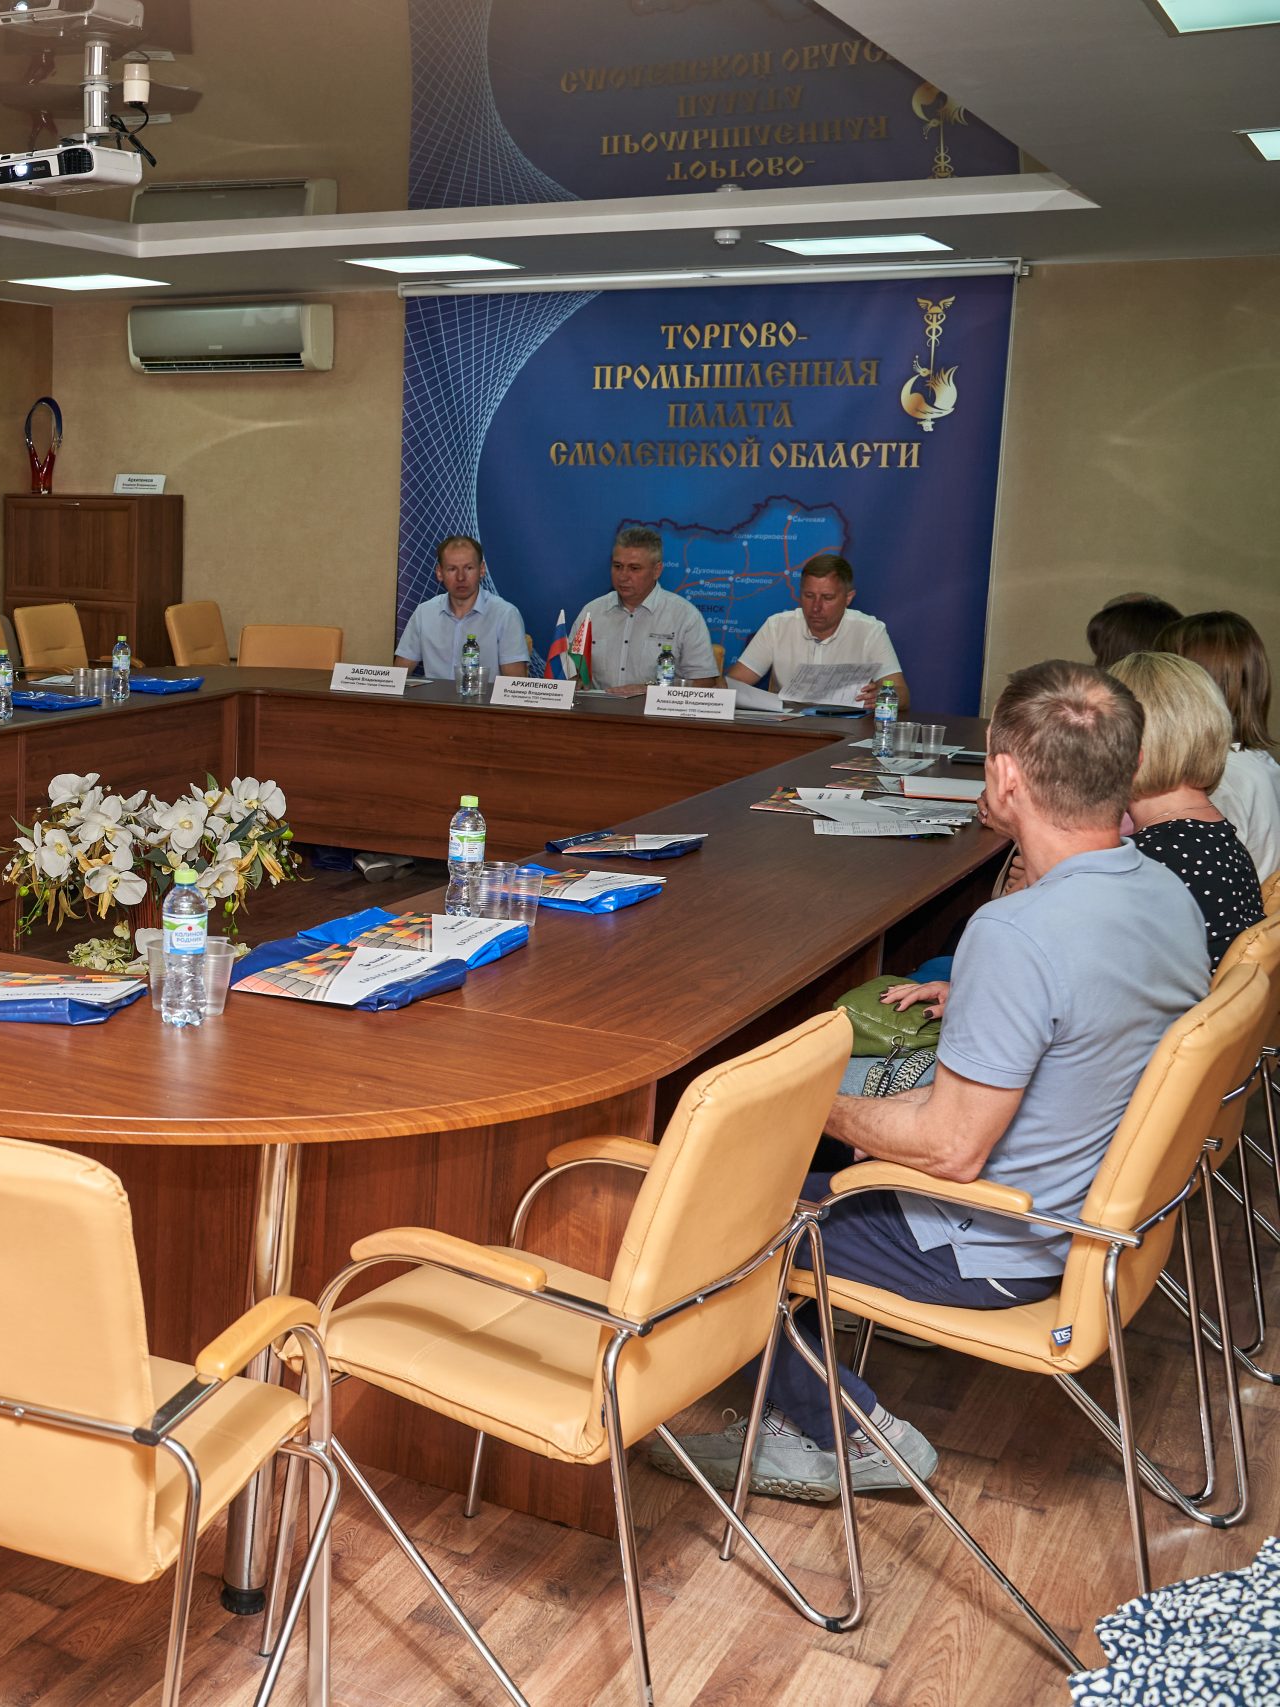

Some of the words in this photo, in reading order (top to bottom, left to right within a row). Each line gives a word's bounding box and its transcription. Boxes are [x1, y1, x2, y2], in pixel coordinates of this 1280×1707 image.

[660, 320, 808, 351] ТОРГОВО-
[592, 359, 880, 391] ПРОМЫШЛЕННАЯ
[666, 401, 794, 429] ПАЛАТА
[549, 436, 760, 468] СМОЛЕНСКОЙ
[769, 441, 922, 469] ОБЛАСТИ
[351, 668, 390, 677] ЗАБЛОЦКИЙ
[511, 680, 559, 690] АРХИПЕНКОВ
[667, 690, 715, 699] КОНДРУСИК
